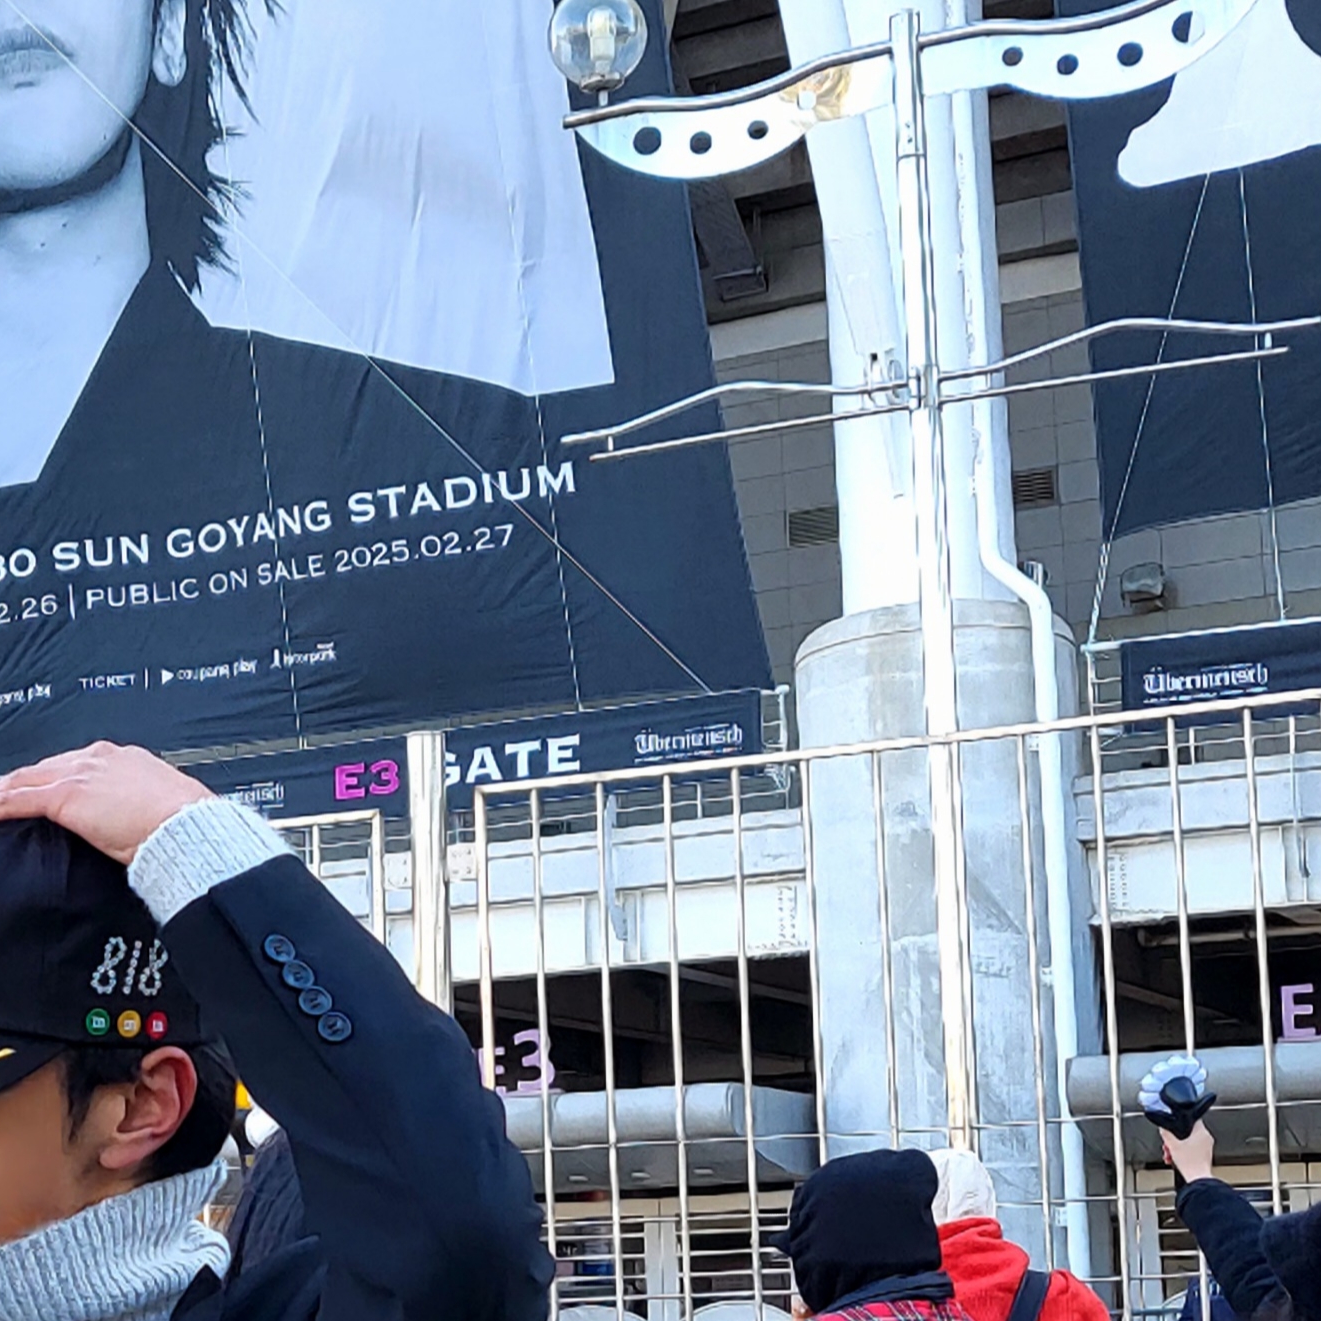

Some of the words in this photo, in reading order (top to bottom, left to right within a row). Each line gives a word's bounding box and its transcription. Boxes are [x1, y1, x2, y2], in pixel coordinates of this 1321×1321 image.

[52, 533, 150, 570] SUN
[166, 500, 333, 558] GOYANG
[348, 460, 576, 525] STADIUM
[85, 578, 200, 610] PUBLIC
[208, 566, 248, 595] ON
[258, 554, 326, 585] SALE
[335, 522, 515, 571] 2025.02.27
[79, 674, 136, 690] TICKET
[233, 657, 258, 677] play
[334, 759, 400, 800] E3
